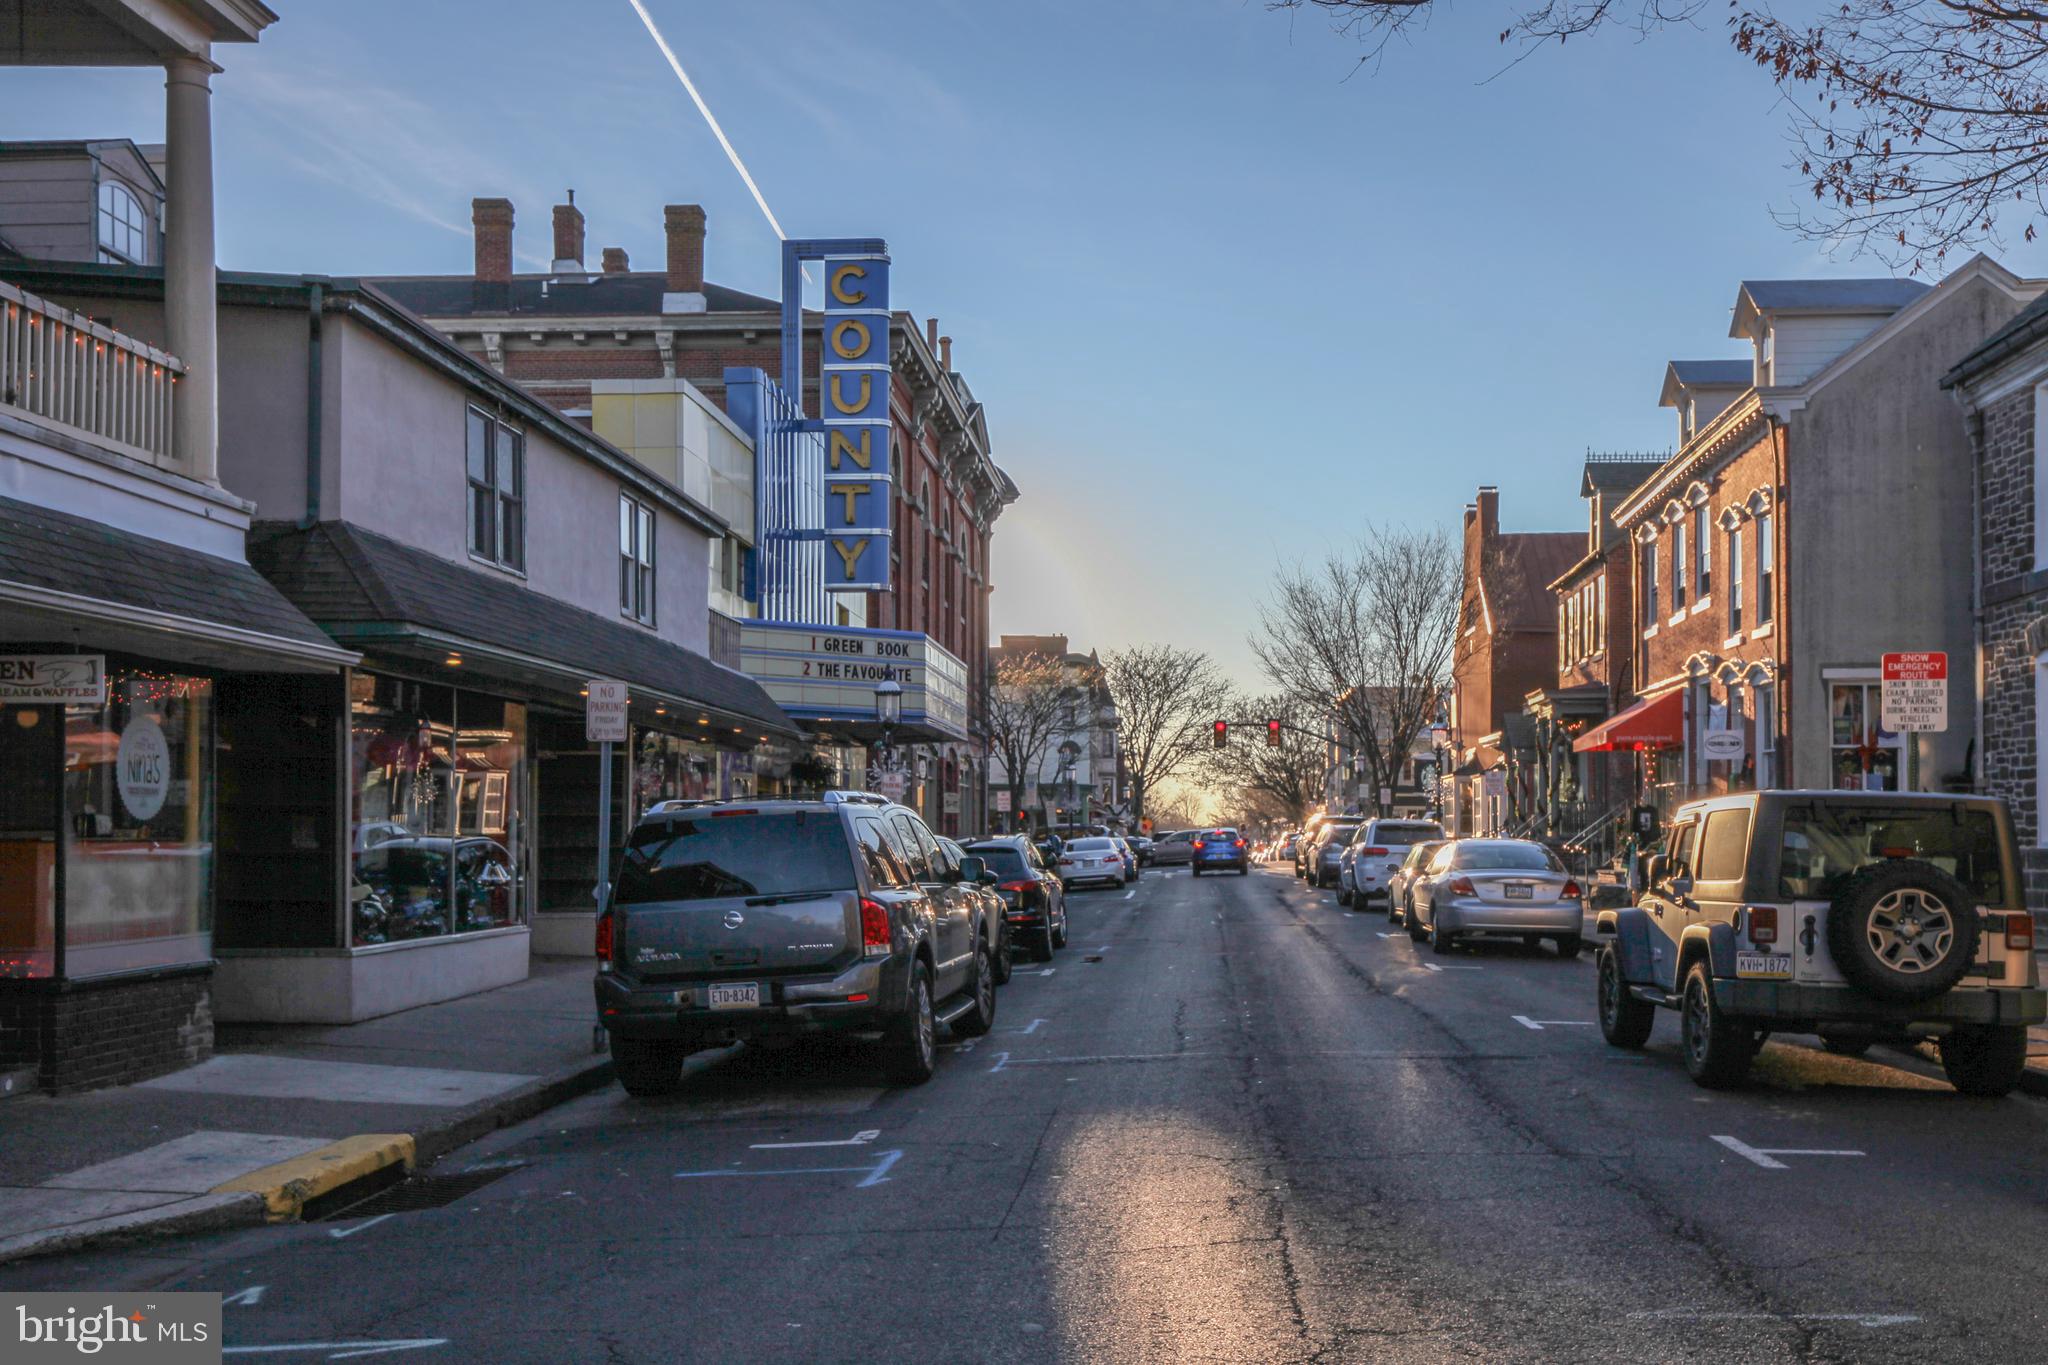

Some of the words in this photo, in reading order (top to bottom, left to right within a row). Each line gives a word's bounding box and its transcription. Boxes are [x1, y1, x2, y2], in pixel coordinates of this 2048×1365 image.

[831, 263, 871, 581] COUNTY
[824, 638, 863, 654] GREEN
[877, 640, 909, 657] BOOK
[1900, 654, 1929, 662] SNOW
[1888, 662, 1941, 671] EMERGENCY
[804, 662, 811, 676] 2
[818, 663, 840, 678] THE
[844, 664, 912, 682] FAVOUITE
[1900, 671, 1929, 679] ROUTE
[600, 687, 615, 698] NO
[1886, 689, 1909, 697] CHAINS
[1913, 689, 1944, 697] REQUIRED
[591, 702, 624, 712] PARKING
[1894, 723, 1914, 731] TOWED
